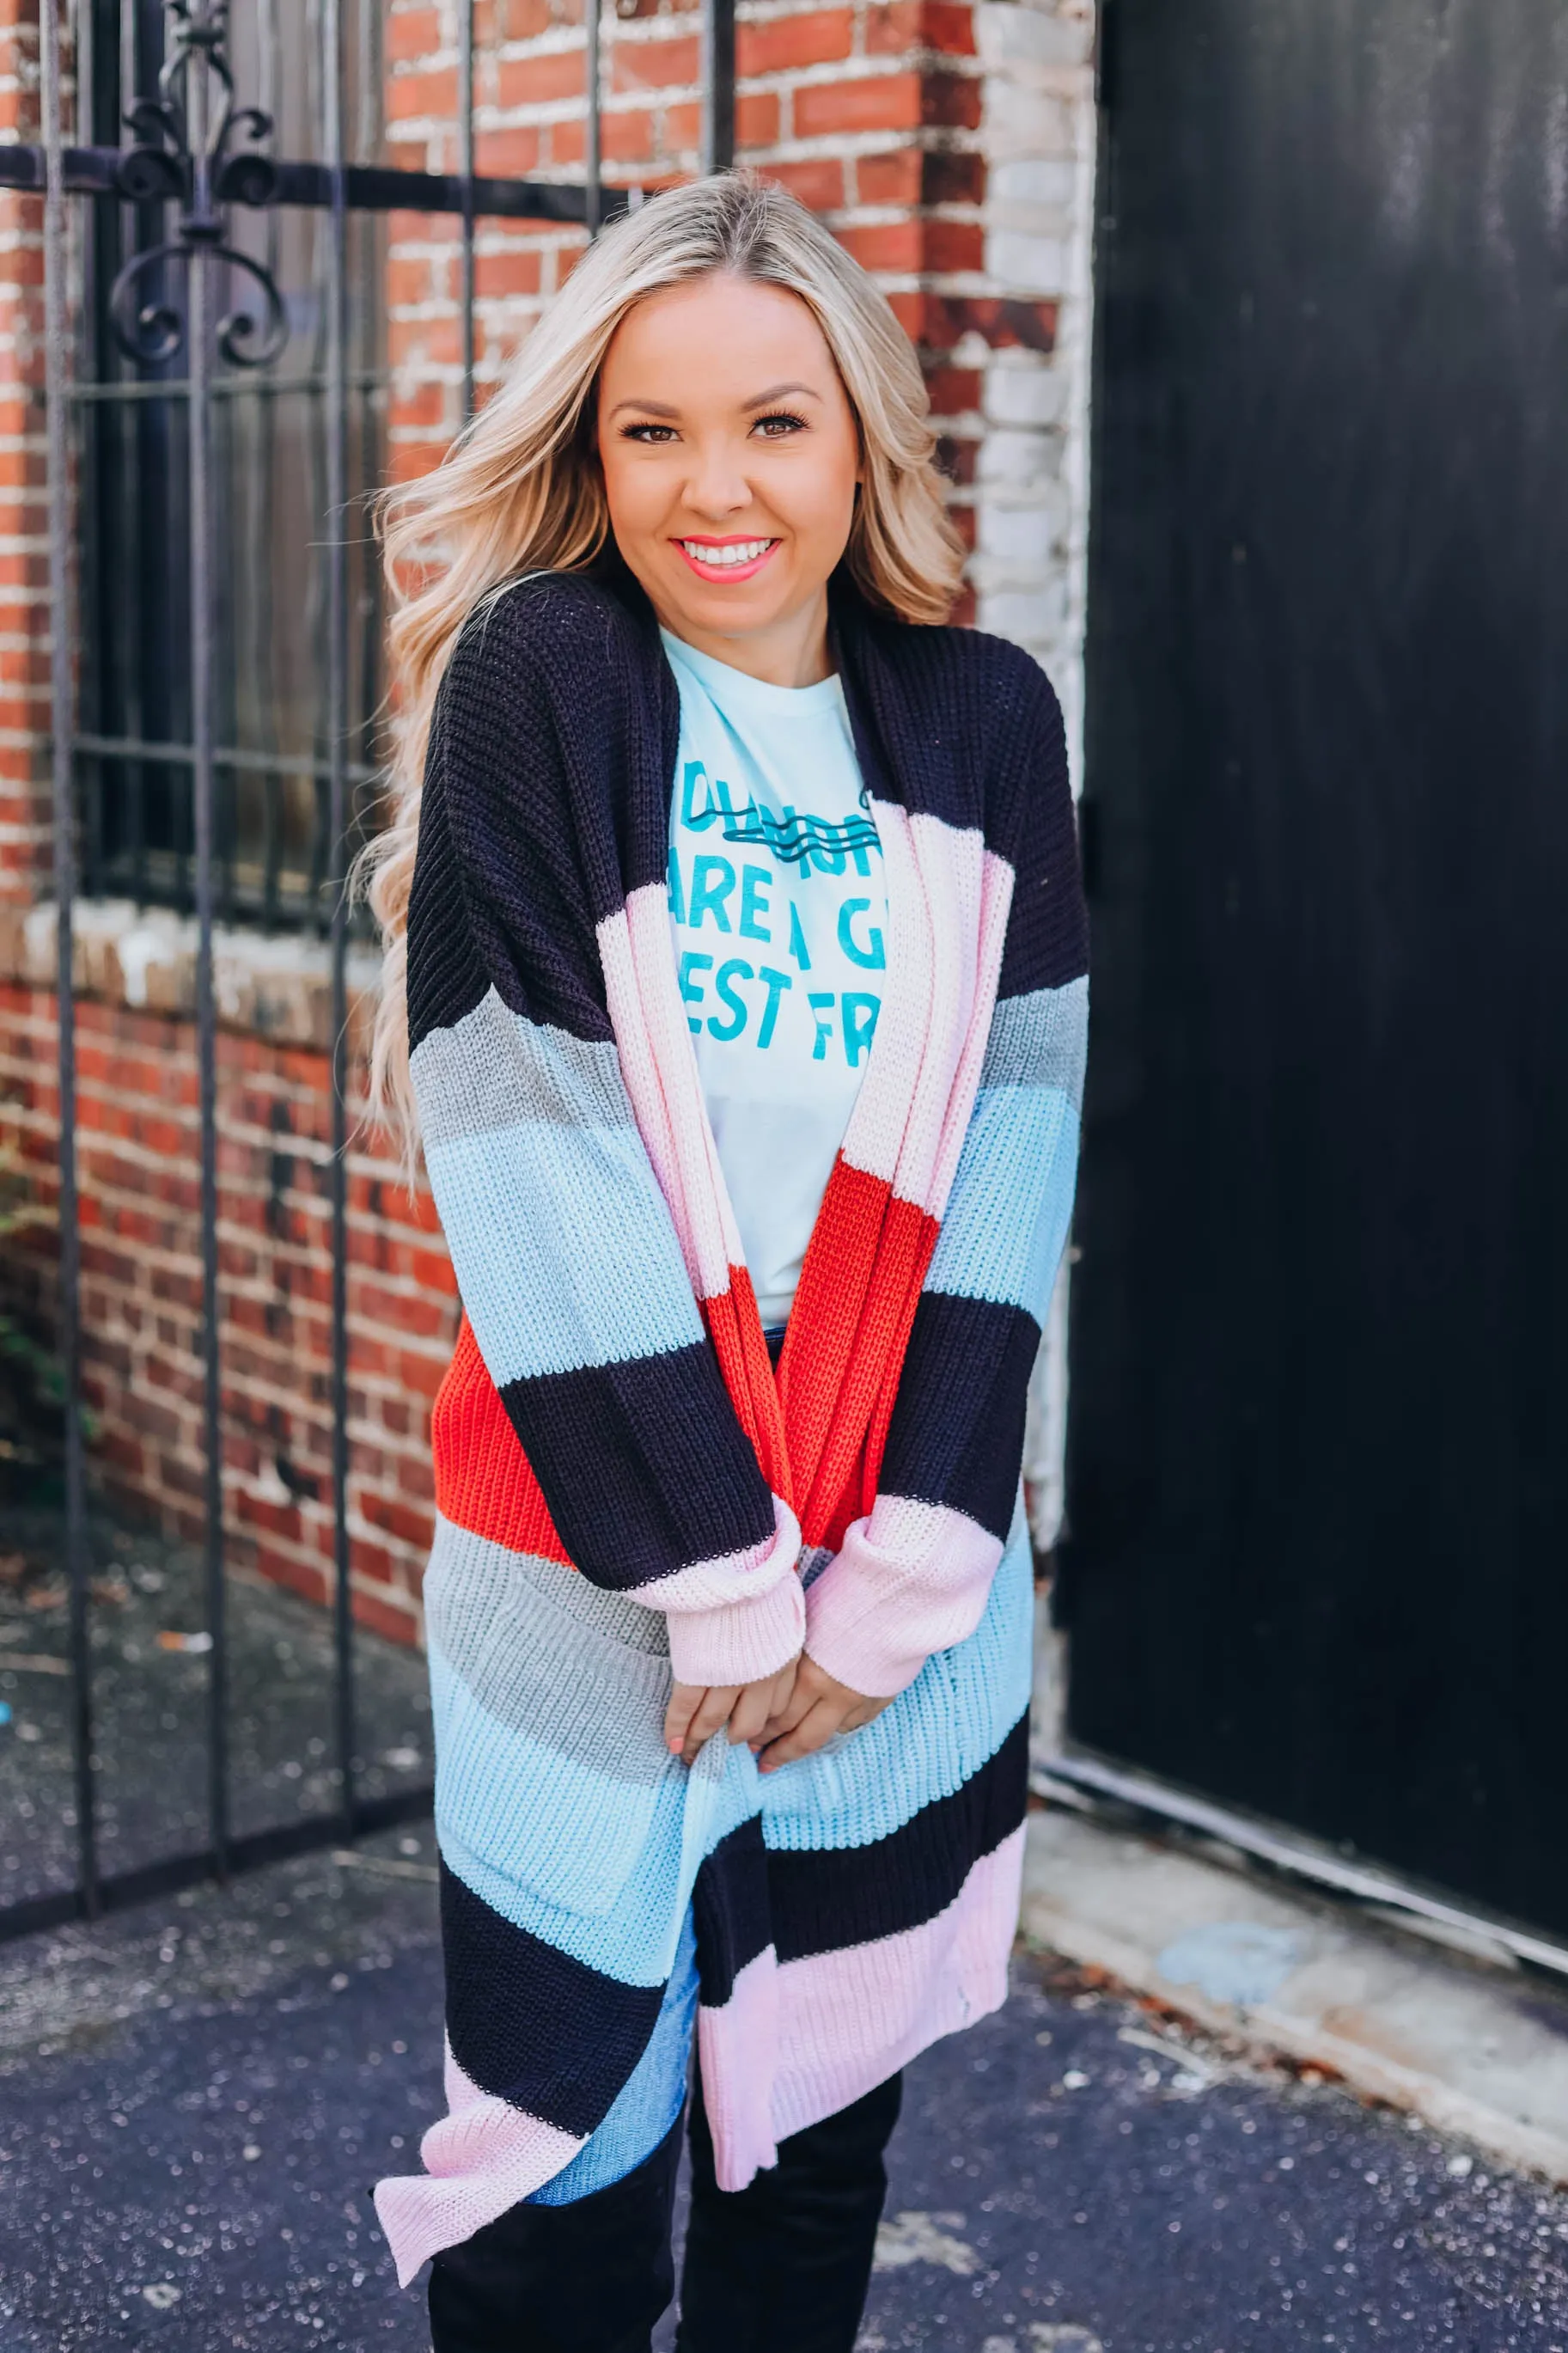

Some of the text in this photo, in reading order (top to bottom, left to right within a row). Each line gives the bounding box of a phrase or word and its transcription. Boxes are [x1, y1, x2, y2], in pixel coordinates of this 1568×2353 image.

[668, 846, 773, 944] ARE
[837, 898, 888, 970] G
[679, 950, 882, 1067] EST FR
